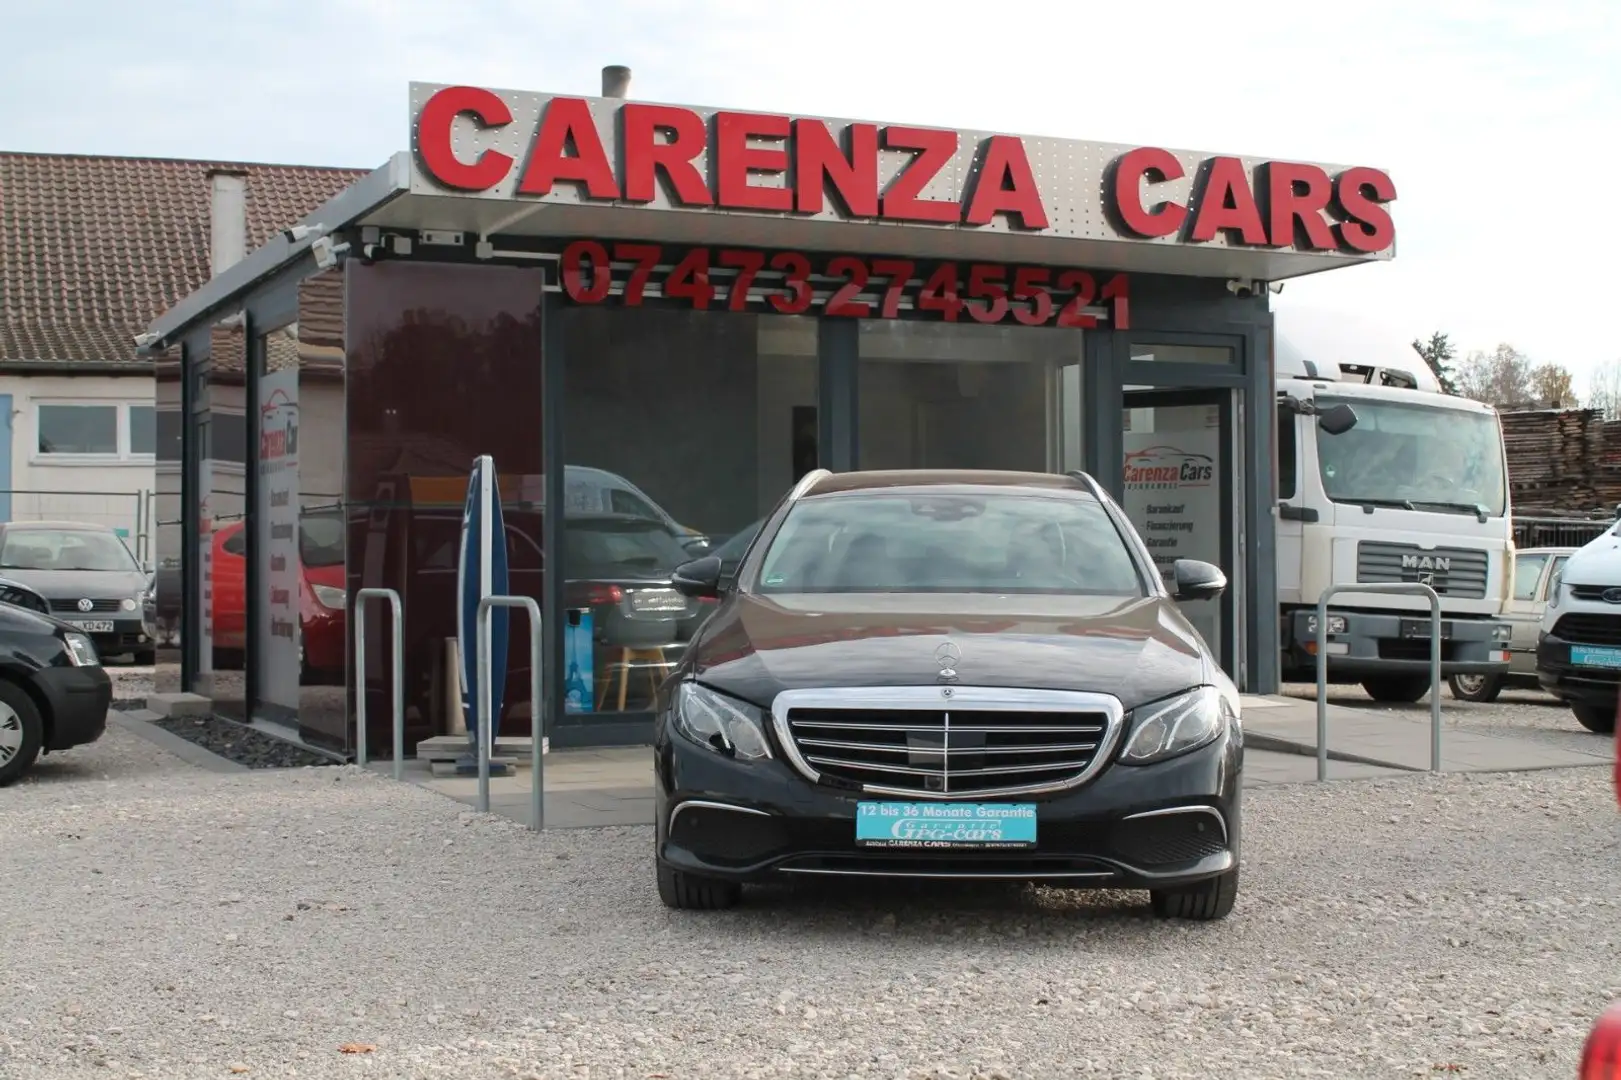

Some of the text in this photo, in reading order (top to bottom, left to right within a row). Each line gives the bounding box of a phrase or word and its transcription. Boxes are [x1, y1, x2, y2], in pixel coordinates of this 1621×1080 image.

[417, 85, 1396, 252] CARENZA CARS
[1124, 463, 1212, 482] Carenza Cars
[1402, 554, 1450, 571] MAN
[861, 805, 1034, 818] 12 bis 36 Monate Garantie
